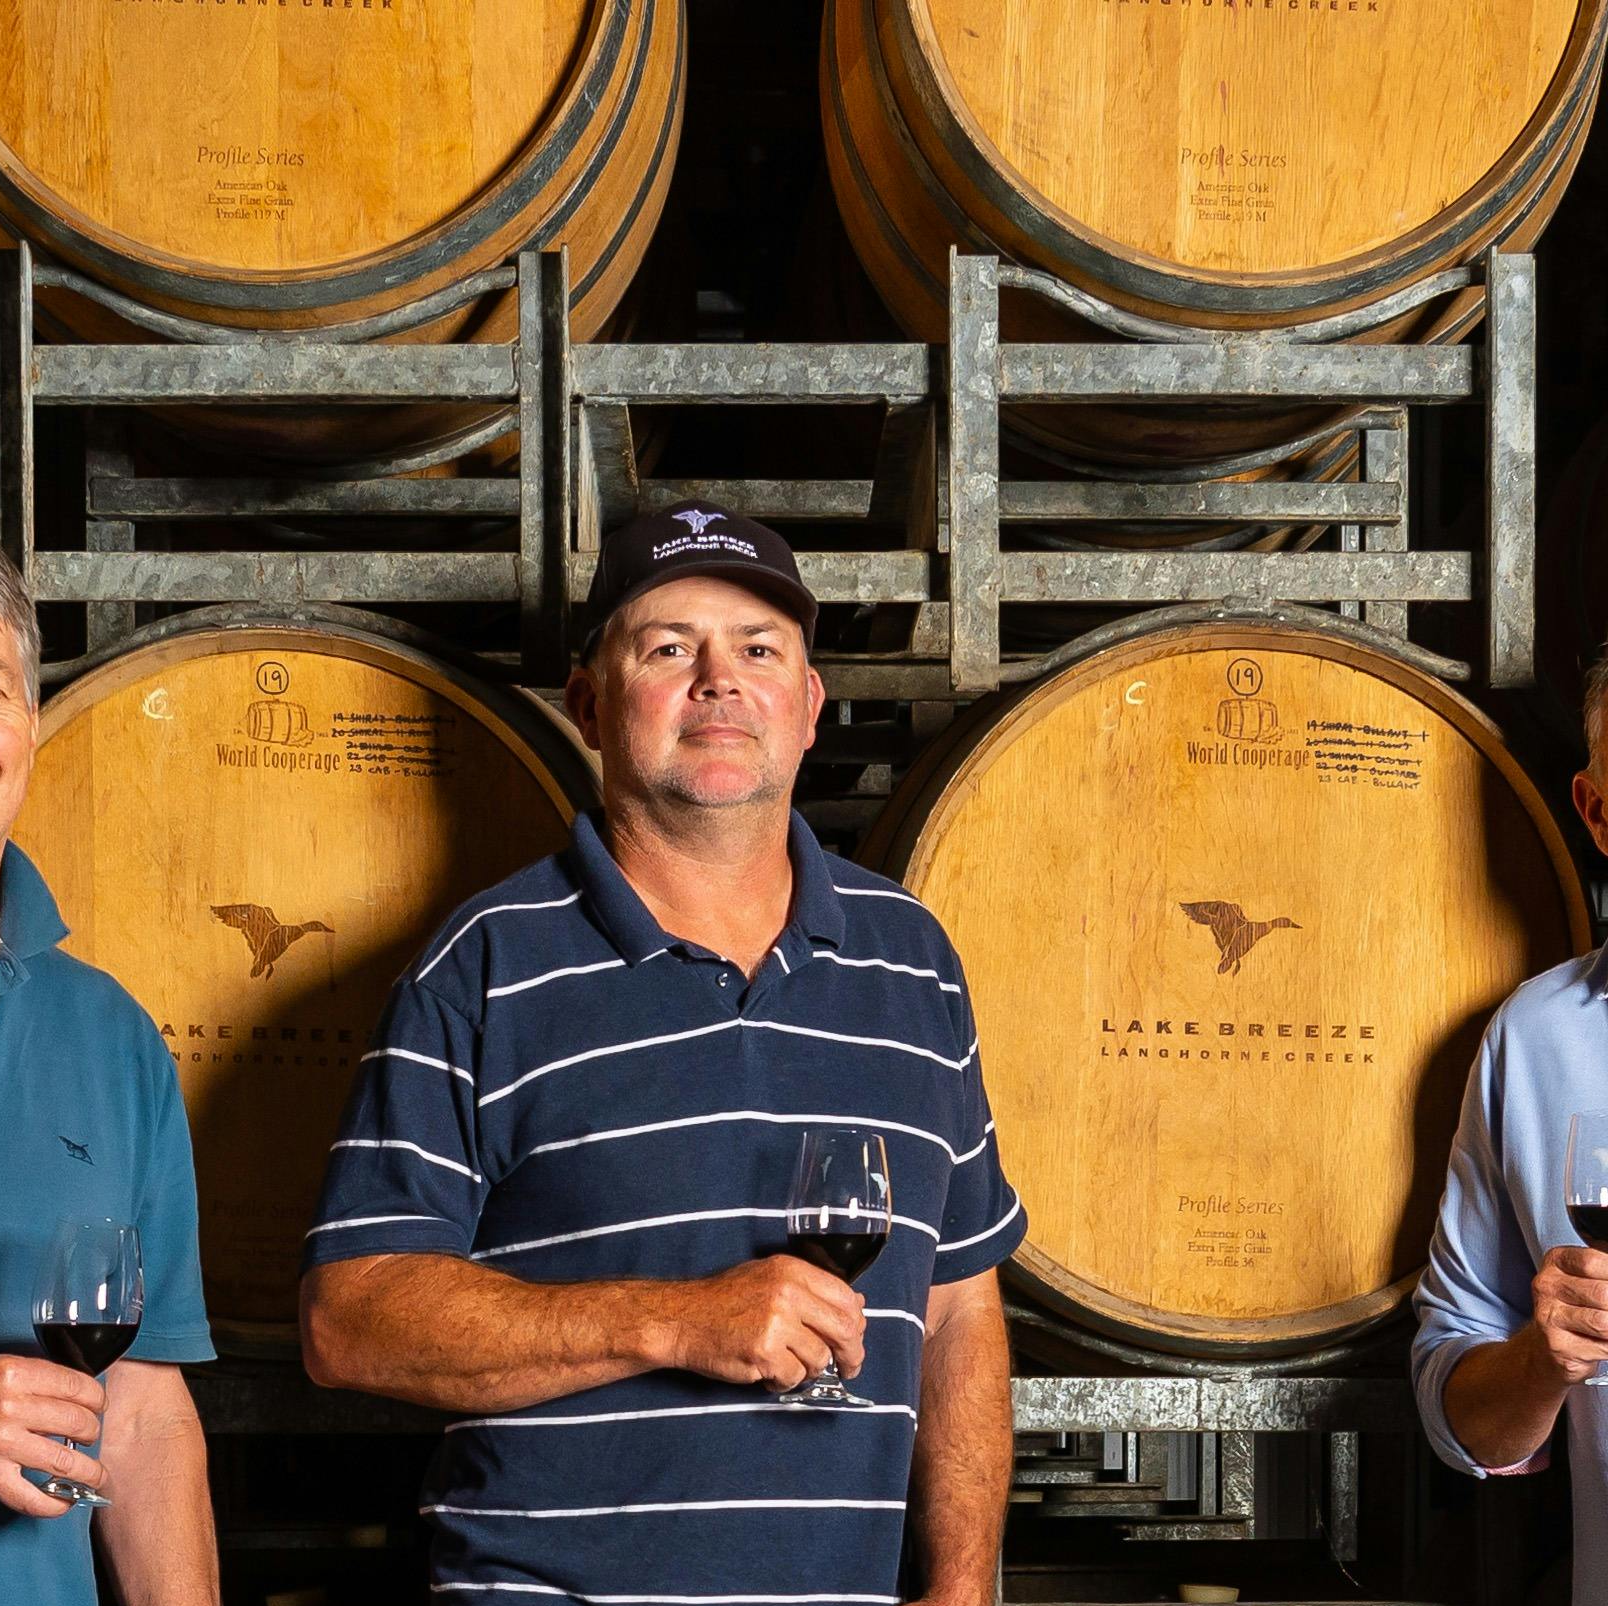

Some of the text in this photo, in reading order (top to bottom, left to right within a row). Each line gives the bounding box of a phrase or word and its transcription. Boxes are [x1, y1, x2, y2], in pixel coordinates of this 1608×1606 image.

[1288, 0, 1377, 11] CREEK
[197, 145, 304, 169] Profile Series
[1181, 146, 1286, 171] Profile Series
[215, 180, 287, 191] American Oak
[216, 208, 250, 219] Profile
[653, 536, 691, 552] LAKE
[264, 671, 282, 690] 19
[1236, 667, 1253, 687] 19
[1125, 681, 1147, 704] C
[216, 743, 257, 767] World
[264, 746, 340, 773] Cooperage
[1187, 742, 1227, 764] World
[1234, 743, 1309, 770] Cooperage
[350, 764, 390, 775] 23 CAB
[1102, 1020, 1374, 1039] LAKE BREEZE
[1102, 1046, 1373, 1064] LANGHORNE CREEK
[1178, 1195, 1284, 1218] Profile Series
[1205, 1256, 1239, 1267] Profile
